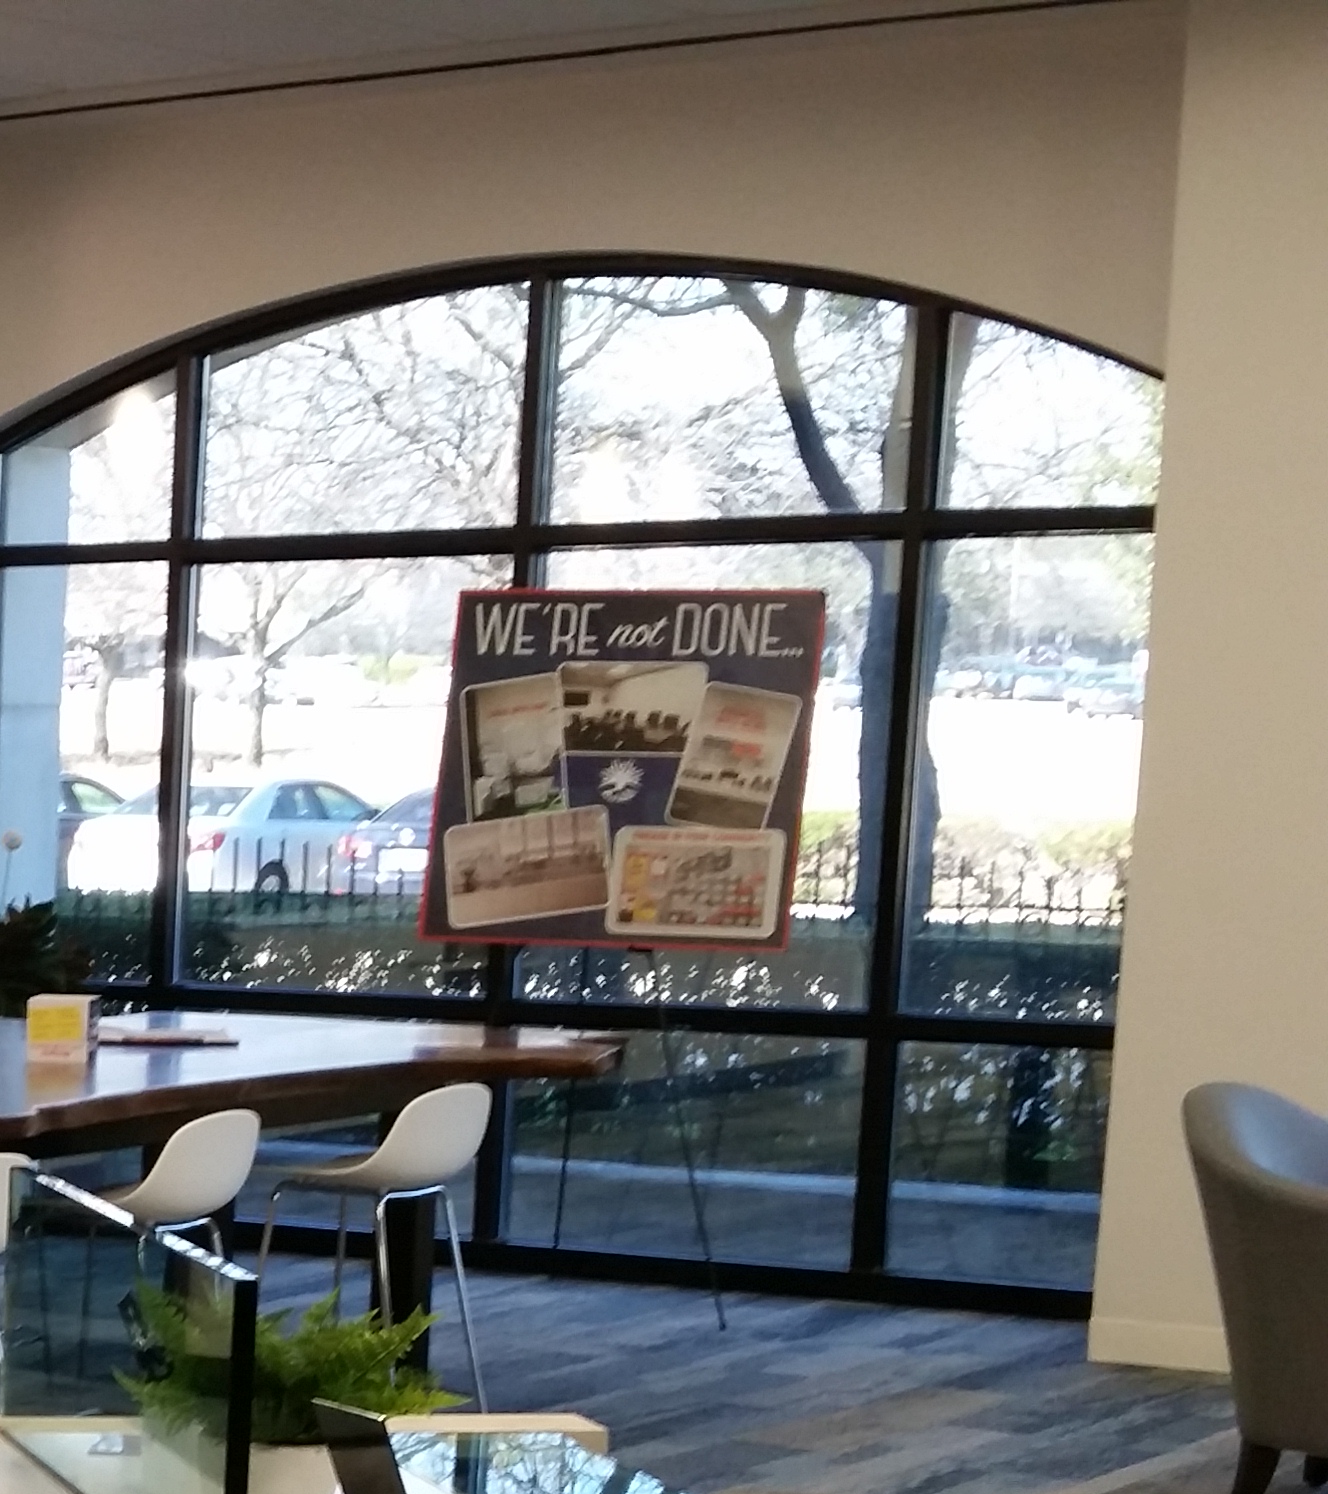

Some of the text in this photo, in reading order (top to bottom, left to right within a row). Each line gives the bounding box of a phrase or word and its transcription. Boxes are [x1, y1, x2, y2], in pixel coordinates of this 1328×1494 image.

[474, 602, 804, 659] WE'RE not DONE...
